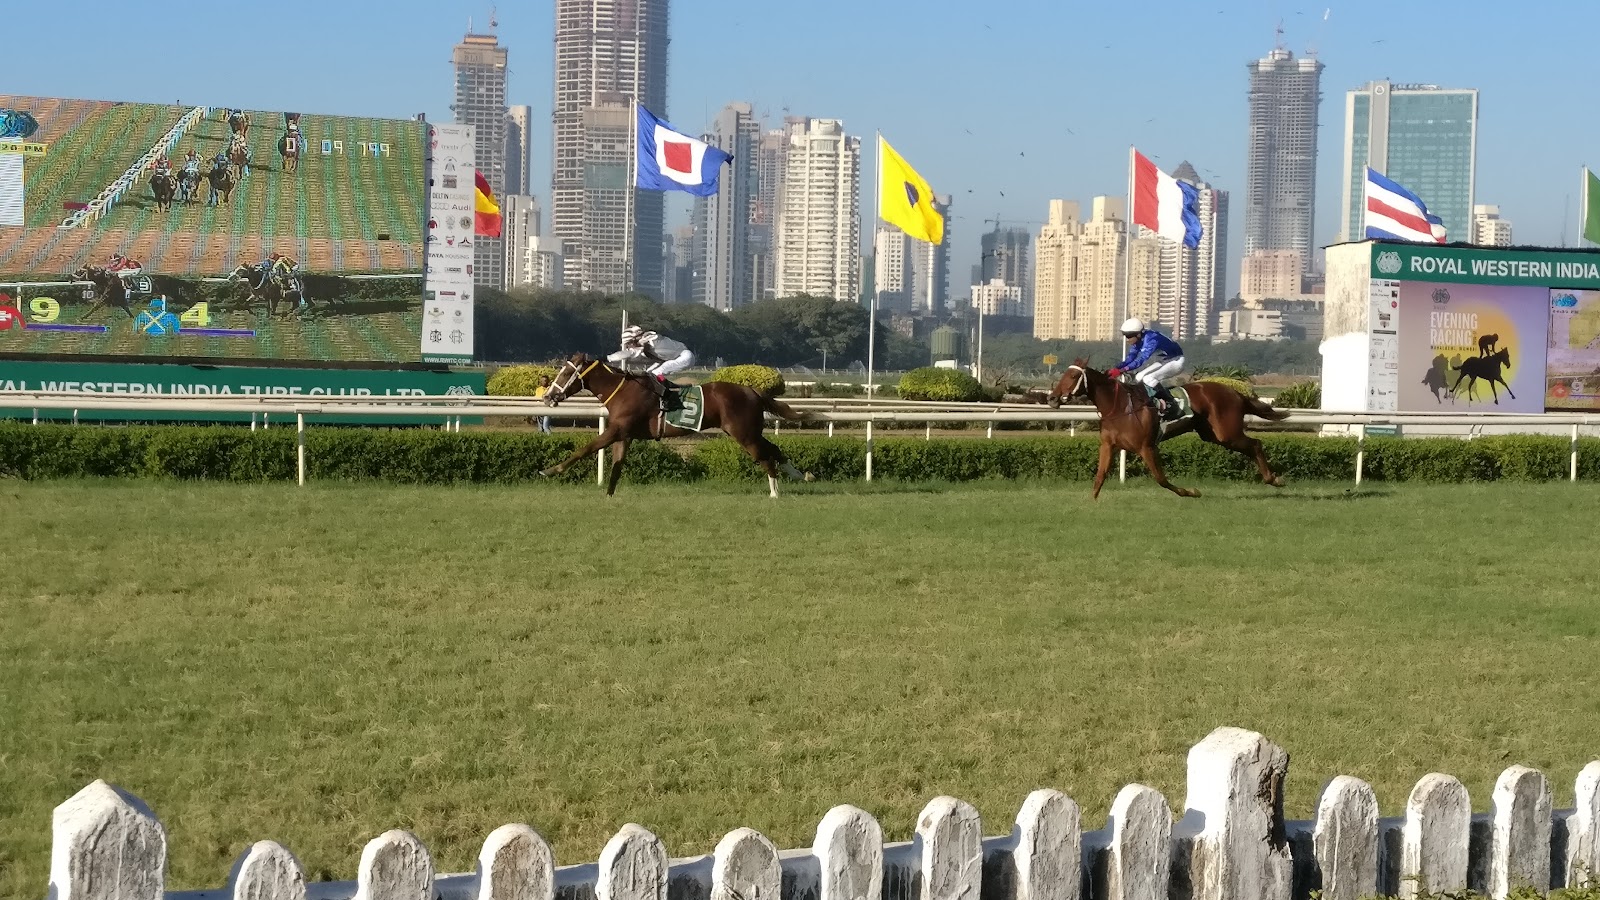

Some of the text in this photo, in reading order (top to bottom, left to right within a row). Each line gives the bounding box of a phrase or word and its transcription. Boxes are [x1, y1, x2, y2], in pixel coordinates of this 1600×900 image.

[1410, 256, 1600, 279] ROYAL WESTERN INDIA
[29, 296, 61, 322] 9
[180, 301, 211, 326] 4
[1430, 311, 1478, 330] EVENING
[1430, 329, 1472, 345] RACING
[171, 383, 232, 395] INDIA
